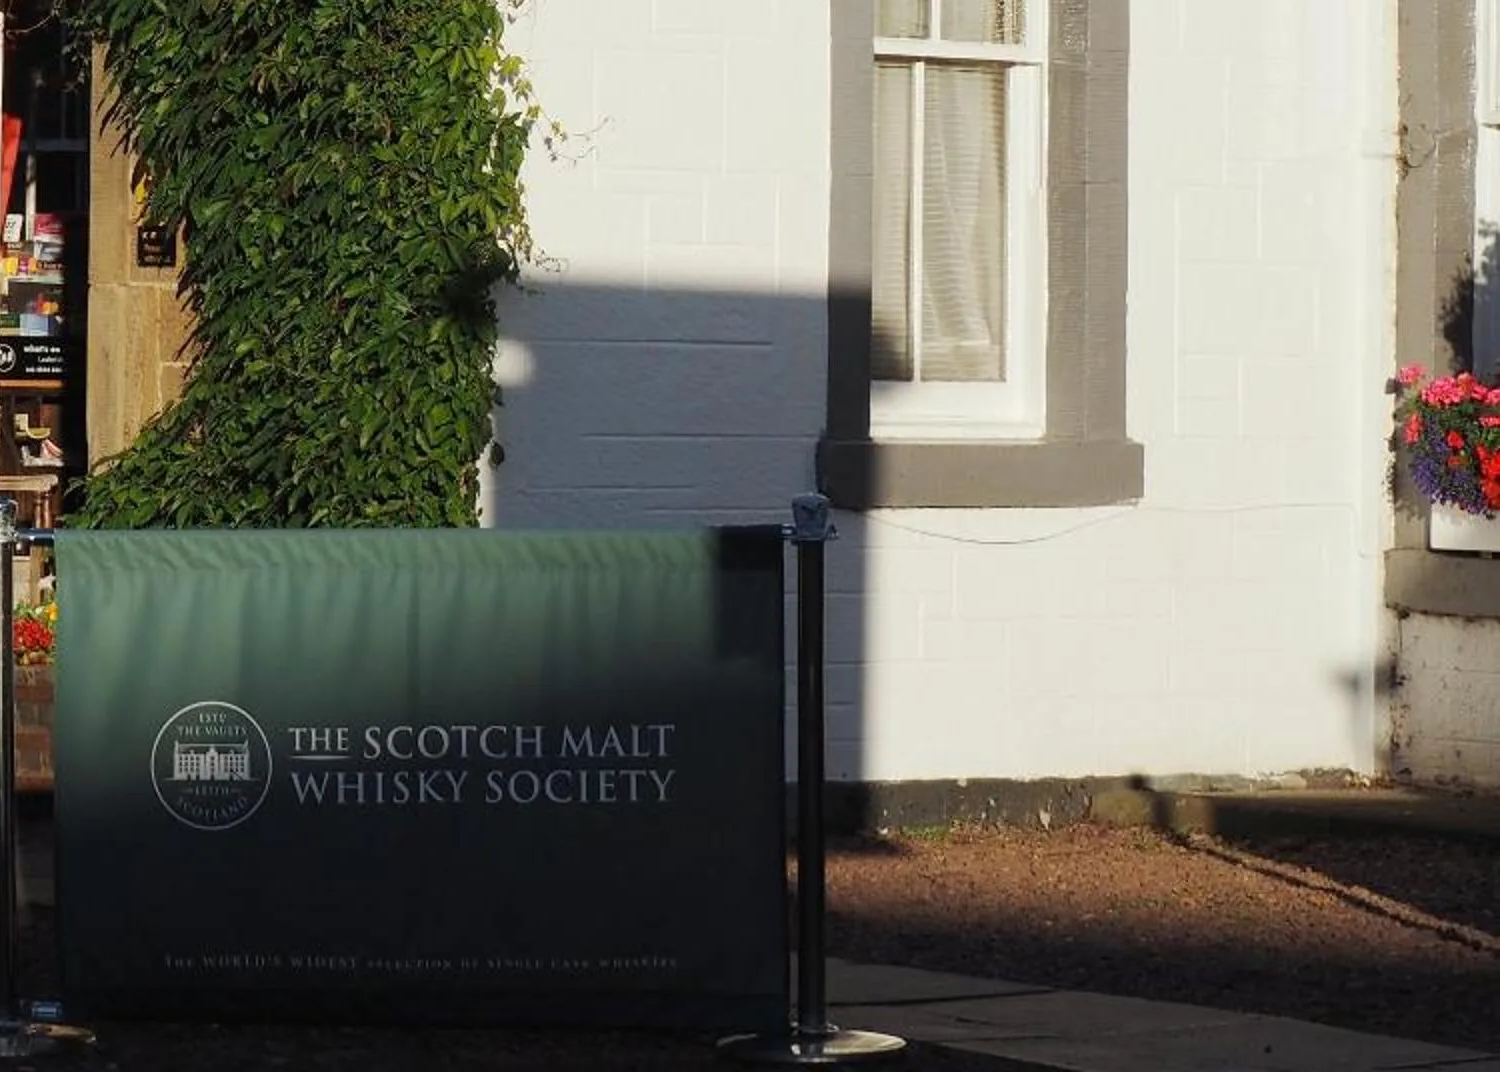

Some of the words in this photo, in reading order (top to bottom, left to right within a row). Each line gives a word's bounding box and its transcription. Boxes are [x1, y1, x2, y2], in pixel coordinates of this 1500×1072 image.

[289, 727, 349, 752] THE
[363, 725, 543, 759] SCOTCH
[560, 724, 675, 758] MALT
[291, 770, 468, 804] WHISKY
[485, 769, 676, 804] SOCIETY
